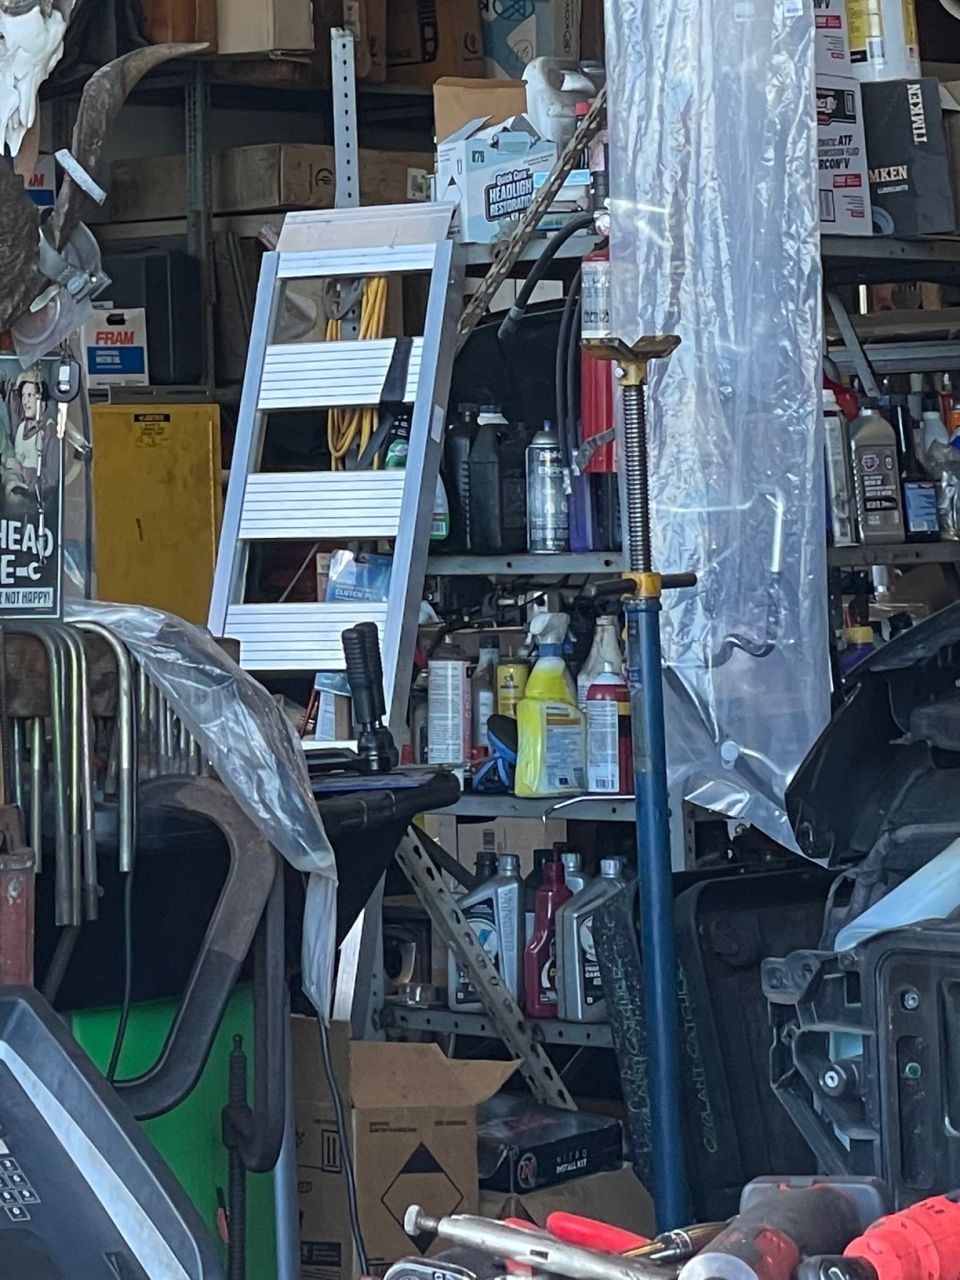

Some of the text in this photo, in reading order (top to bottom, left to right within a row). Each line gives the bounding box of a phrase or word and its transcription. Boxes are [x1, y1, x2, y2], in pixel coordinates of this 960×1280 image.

[907, 84, 927, 144] TIMKEN
[838, 135, 853, 146] ATF
[870, 165, 908, 183] MKEN
[490, 178, 532, 203] HEADLIGH
[490, 195, 531, 217] RESTORATIO
[95, 331, 135, 345] FRAM
[5, 591, 20, 604] NOT
